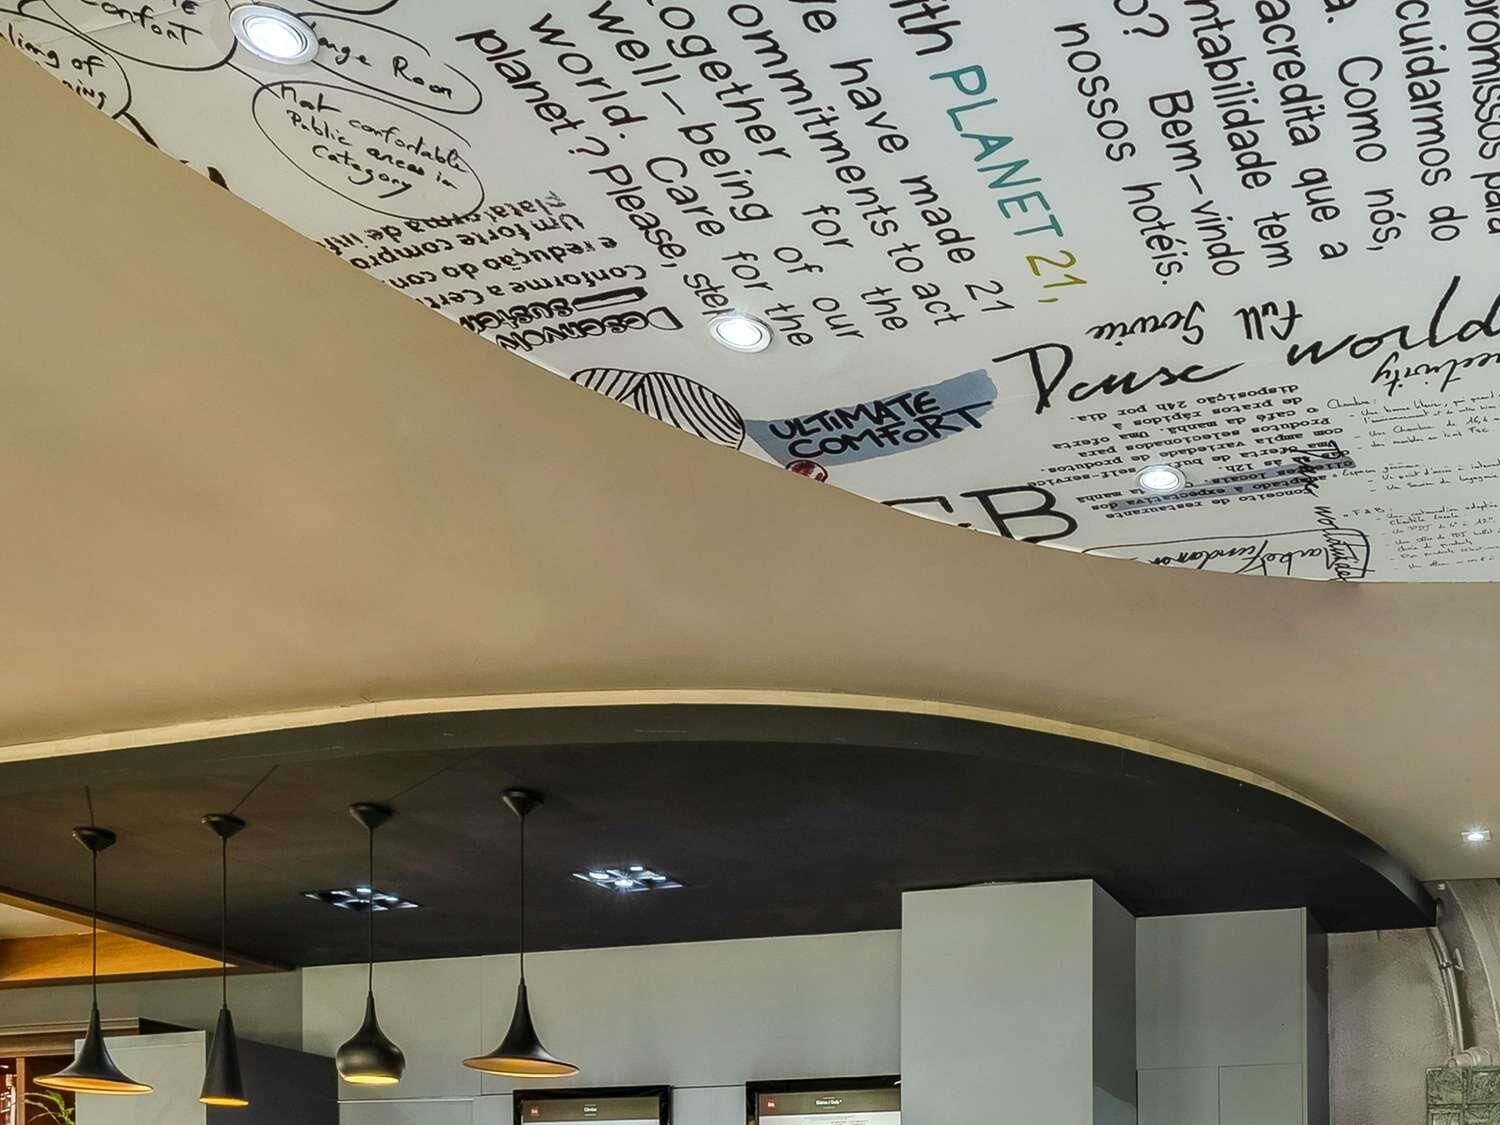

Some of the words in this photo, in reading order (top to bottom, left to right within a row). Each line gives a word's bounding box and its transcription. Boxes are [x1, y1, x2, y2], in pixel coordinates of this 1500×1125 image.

[888, 0, 961, 57] ith
[929, 64, 1064, 238] PLANET
[1338, 56, 1387, 162] Como
[286, 110, 352, 146] Public
[1184, 0, 1277, 189] ntabilidade
[1254, 211, 1293, 268] tem
[1255, 0, 1326, 146] acredita
[1292, 167, 1341, 222] que
[1320, 241, 1348, 260] a
[657, 0, 792, 159] ogether
[802, 205, 853, 248] for
[860, 287, 908, 331] the
[727, 4, 899, 237] ommitments
[888, 242, 924, 273] to
[912, 282, 966, 326] act
[1054, 23, 1136, 162] nossos
[1122, 182, 1189, 285] hotéis.
[455, 29, 610, 157] planet?
[588, 165, 687, 268] Please,
[683, 273, 737, 317] ste
[530, 13, 648, 140] world.
[646, 157, 726, 237] Care
[722, 251, 773, 291] for
[765, 303, 814, 347] the
[830, 58, 909, 154] have
[900, 175, 976, 263] made
[965, 280, 1015, 312] 21
[1149, 90, 1245, 276] Bem-vindo
[457, 222, 531, 246] forte
[1428, 206, 1468, 241] do
[442, 264, 479, 280] do
[483, 239, 596, 270] redução
[511, 265, 647, 294] Conforme
[773, 247, 823, 274] of
[812, 297, 864, 339] our
[1118, 405, 1147, 416] por
[1196, 384, 1299, 405] disposição
[1211, 397, 1273, 415] pratos
[1282, 396, 1303, 406] de
[768, 391, 937, 441] ULTIMATE
[787, 400, 994, 458] COMFORT
[1251, 417, 1330, 434] Produtos
[1052, 436, 1109, 449] oferta
[1078, 446, 1115, 459] para
[1124, 429, 1241, 451] selecionados
[1159, 440, 1246, 458] variedade
[1255, 429, 1304, 443] ampla
